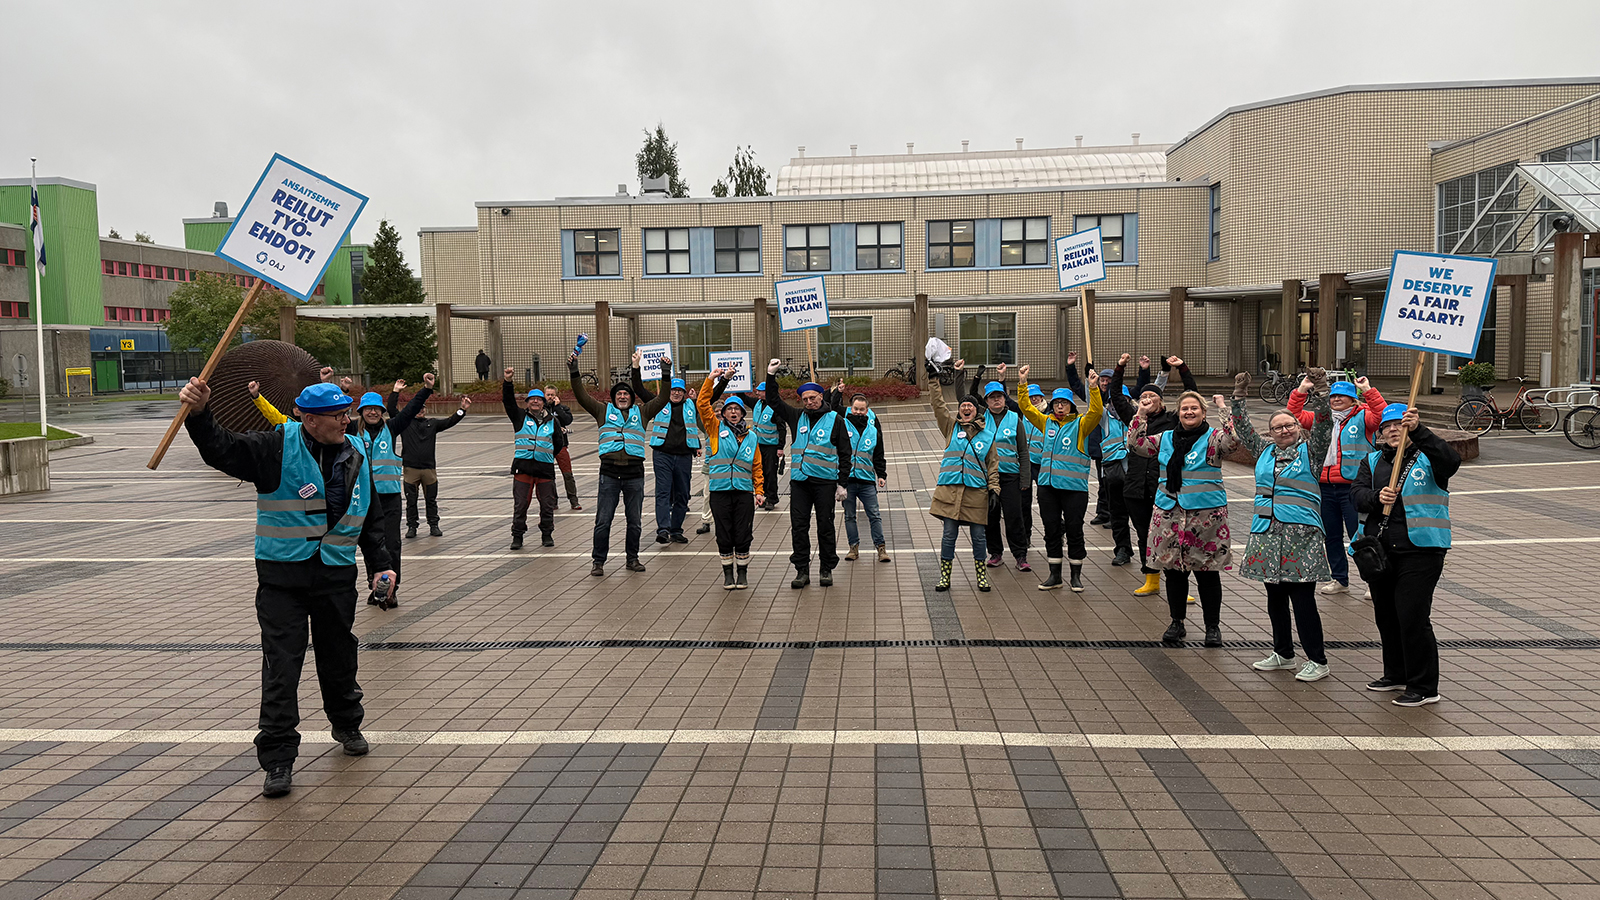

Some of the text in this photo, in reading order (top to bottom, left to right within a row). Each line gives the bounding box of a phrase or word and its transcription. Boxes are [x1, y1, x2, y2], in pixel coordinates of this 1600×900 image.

[281, 178, 341, 211] ANSAITSEMME
[270, 188, 334, 227] REILUT
[271, 209, 313, 237] TYÖ-
[248, 221, 316, 264] EHDOT!
[1061, 254, 1099, 271] PALKAN!
[1064, 246, 1095, 262] REILUN
[268, 259, 286, 272] OAJ
[1429, 266, 1454, 280] WE
[785, 287, 817, 296] ANSAITSEMME
[1402, 279, 1473, 298] DESERVE
[783, 301, 823, 314] PALKAN!
[785, 293, 818, 305] REILUN
[1408, 294, 1460, 311] A FAIR
[1398, 307, 1465, 327] SALARY!
